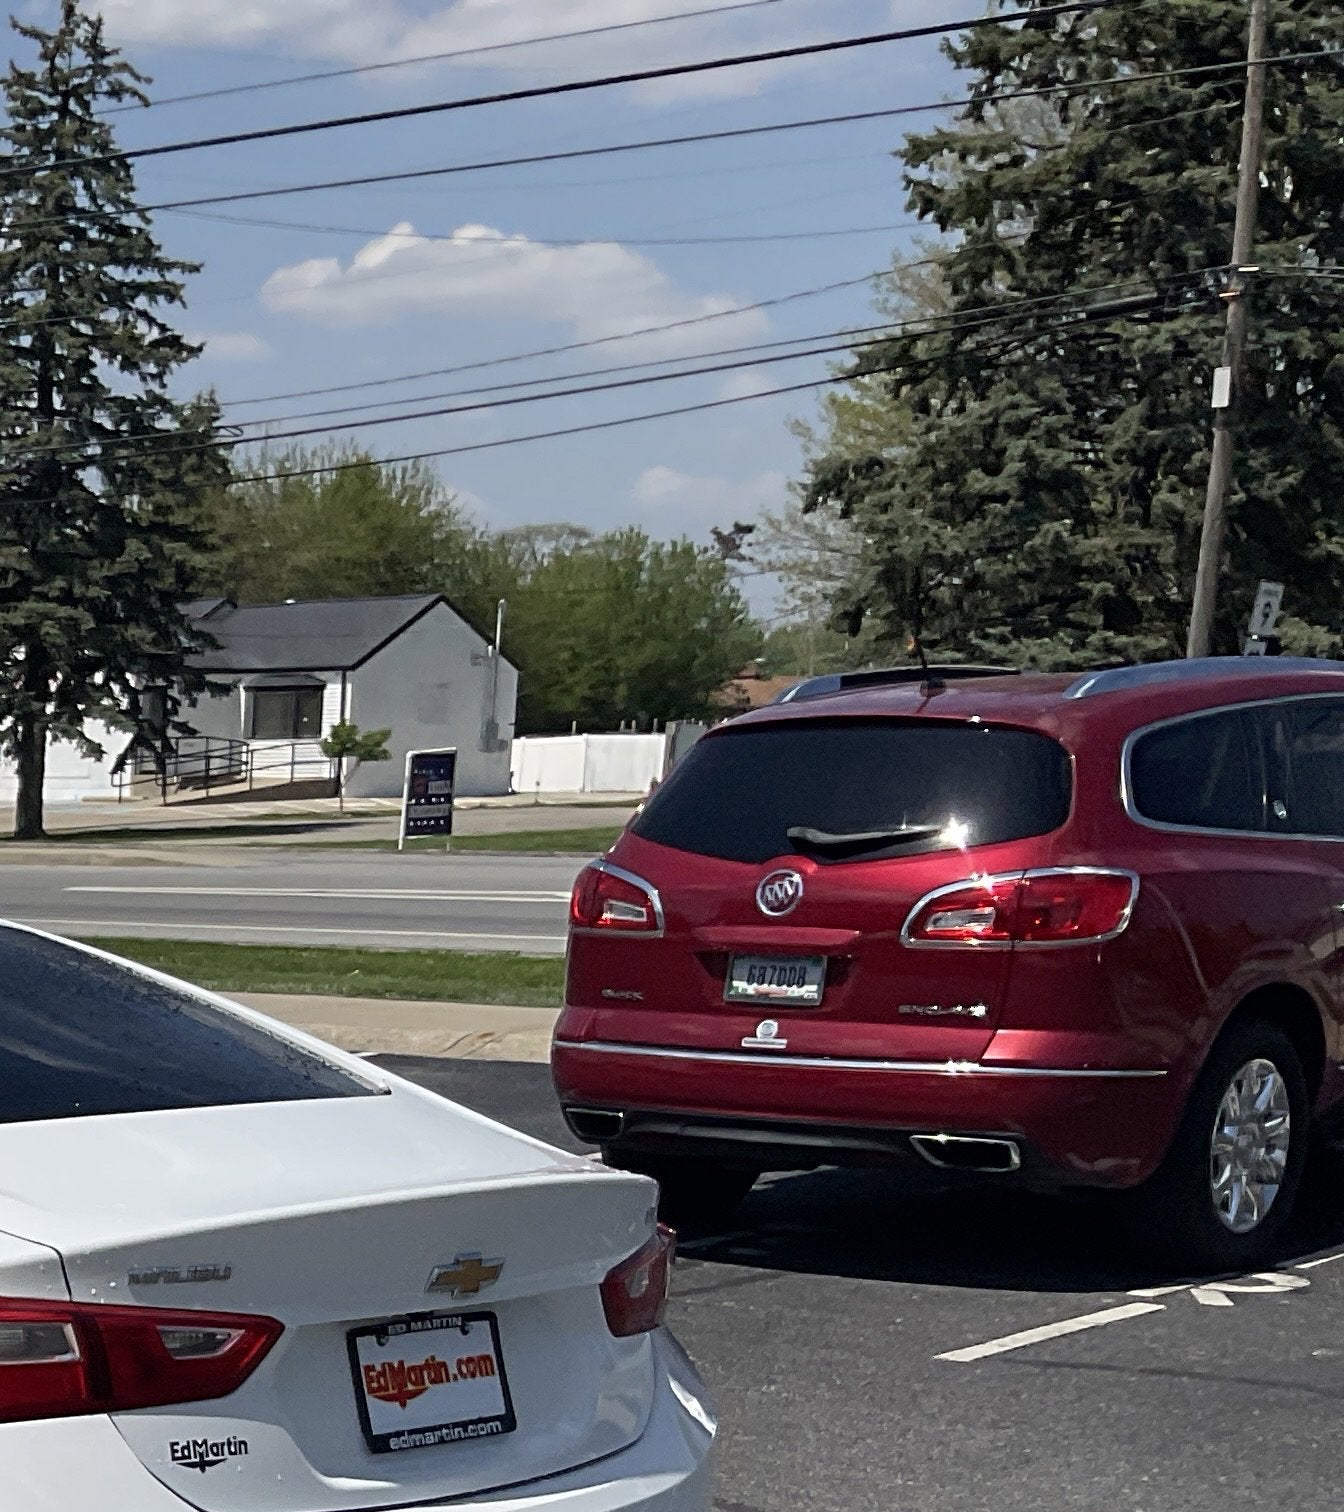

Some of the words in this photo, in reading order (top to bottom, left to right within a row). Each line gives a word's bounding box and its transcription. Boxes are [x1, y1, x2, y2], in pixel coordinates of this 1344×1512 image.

[388, 1324, 407, 1336] ED
[410, 1316, 463, 1332] MARTIN
[363, 1353, 495, 1396] EdMartin.com
[169, 1435, 249, 1464] EdMartin
[389, 1420, 503, 1450] edmartin.com
